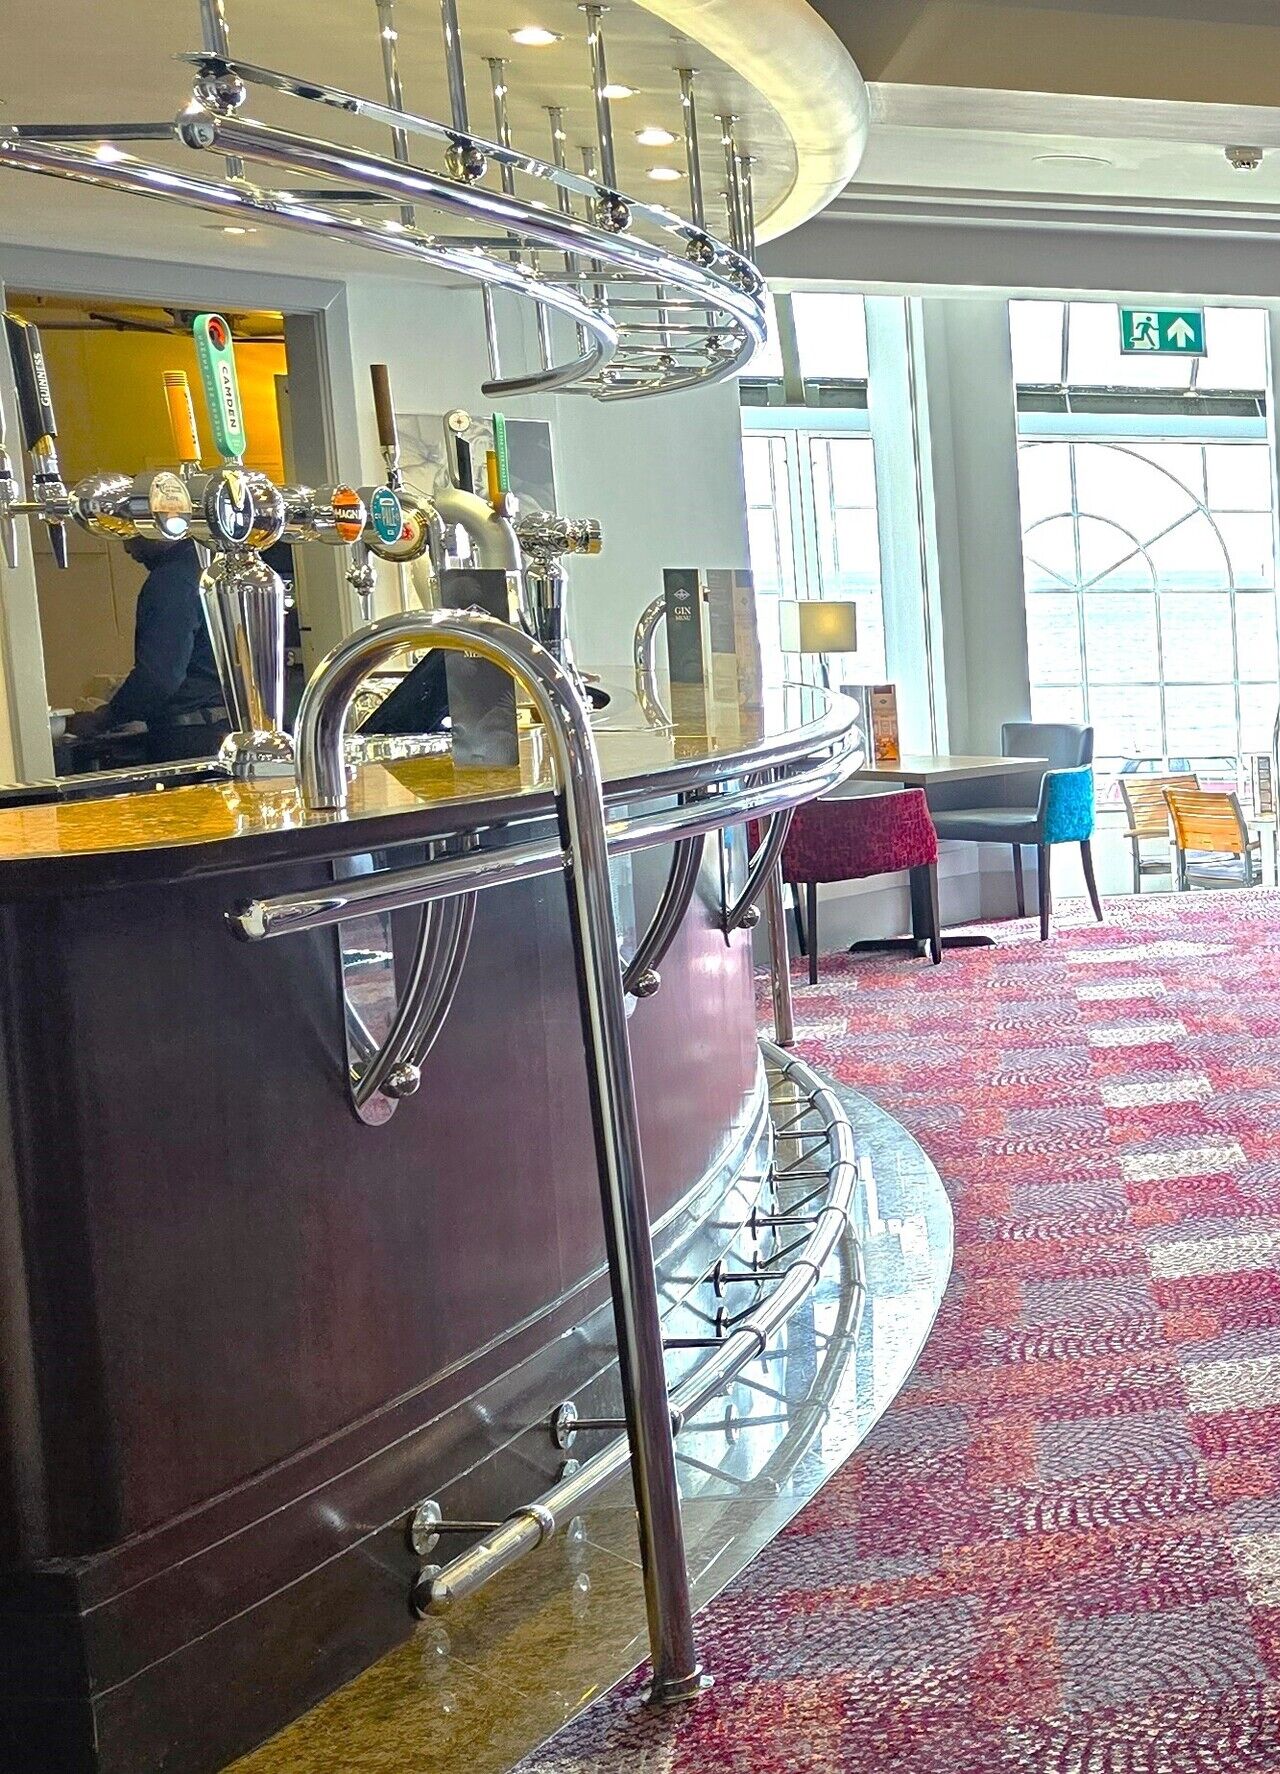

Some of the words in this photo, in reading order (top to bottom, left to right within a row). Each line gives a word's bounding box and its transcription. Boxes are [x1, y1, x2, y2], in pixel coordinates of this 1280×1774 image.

[33, 352, 51, 407] GUINNESS
[222, 366, 237, 428] CAMDEN
[674, 606, 692, 615] GIN
